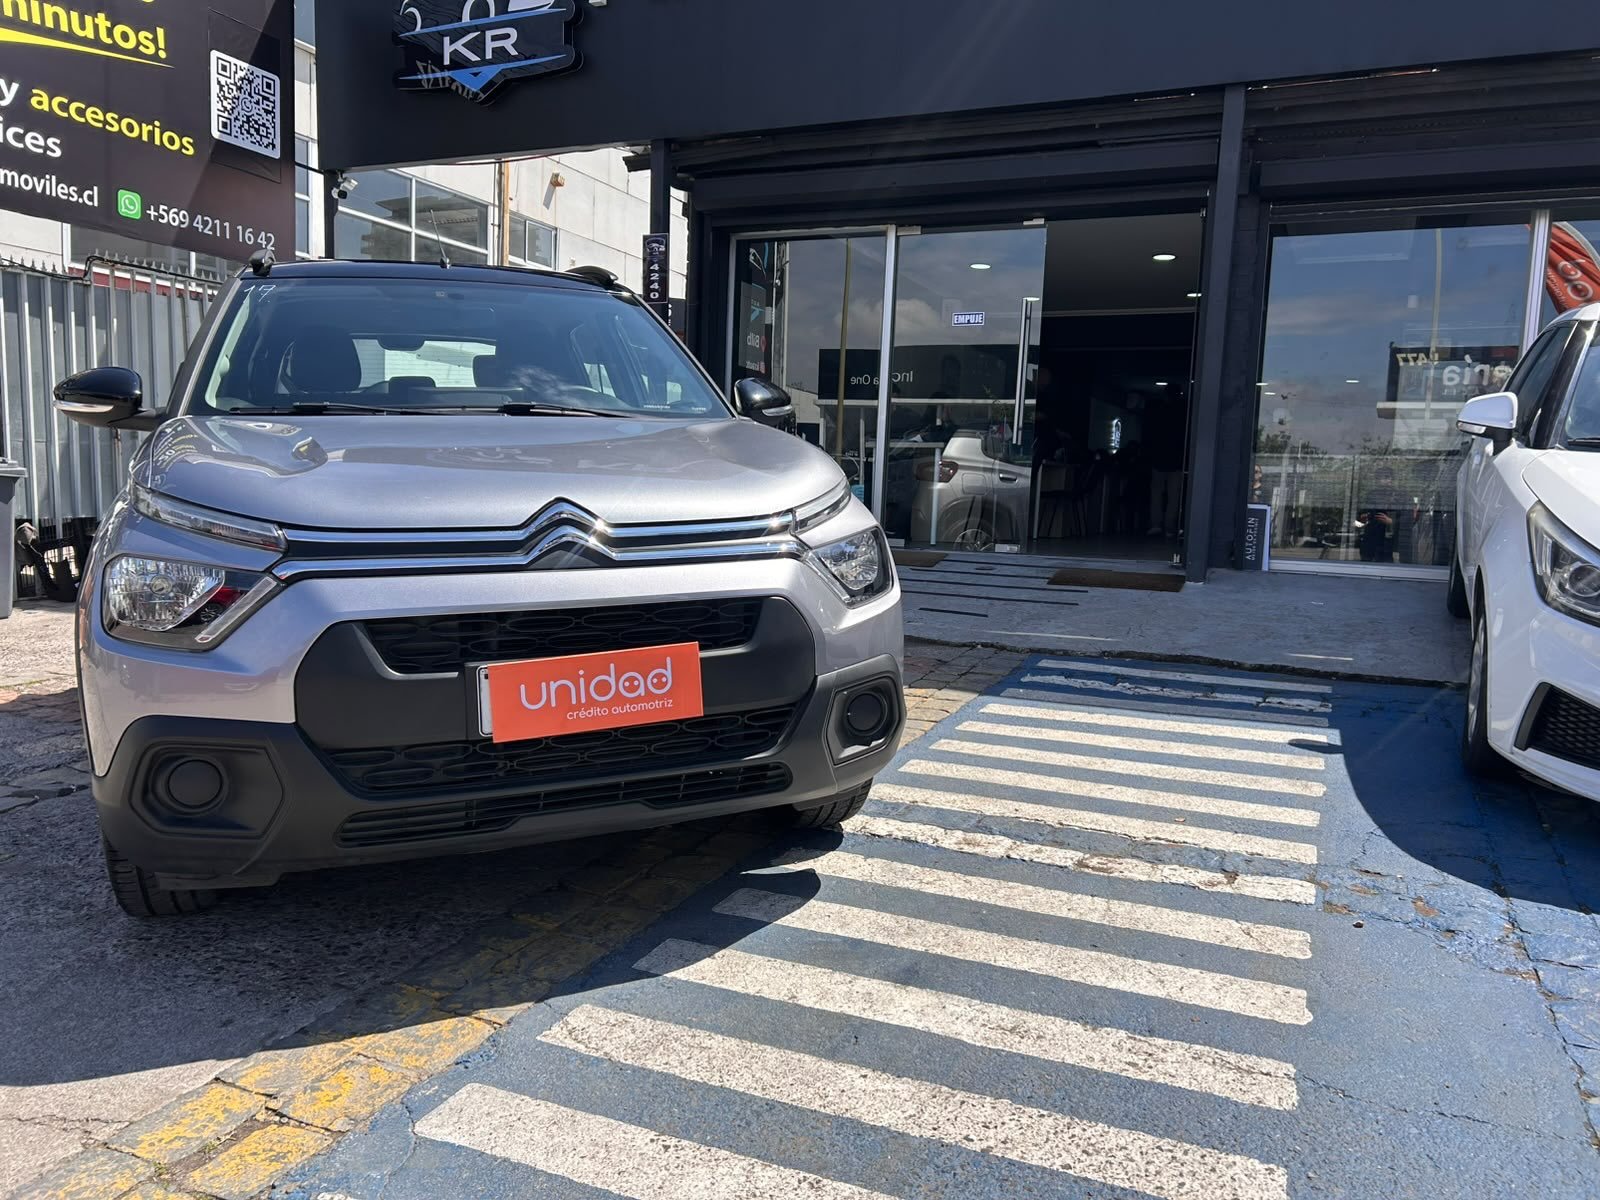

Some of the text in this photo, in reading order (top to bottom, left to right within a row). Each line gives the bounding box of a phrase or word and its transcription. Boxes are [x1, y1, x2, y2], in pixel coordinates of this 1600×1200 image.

[443, 27, 519, 65] KR
[30, 87, 195, 156] accesorios
[0, 167, 99, 207] moviles.cl
[146, 204, 275, 250] +569 4211 16 42
[649, 263, 660, 299] 4240
[953, 313, 984, 325] EMPUJE
[519, 656, 672, 710] unidad
[566, 698, 673, 720] crédito automotriz
